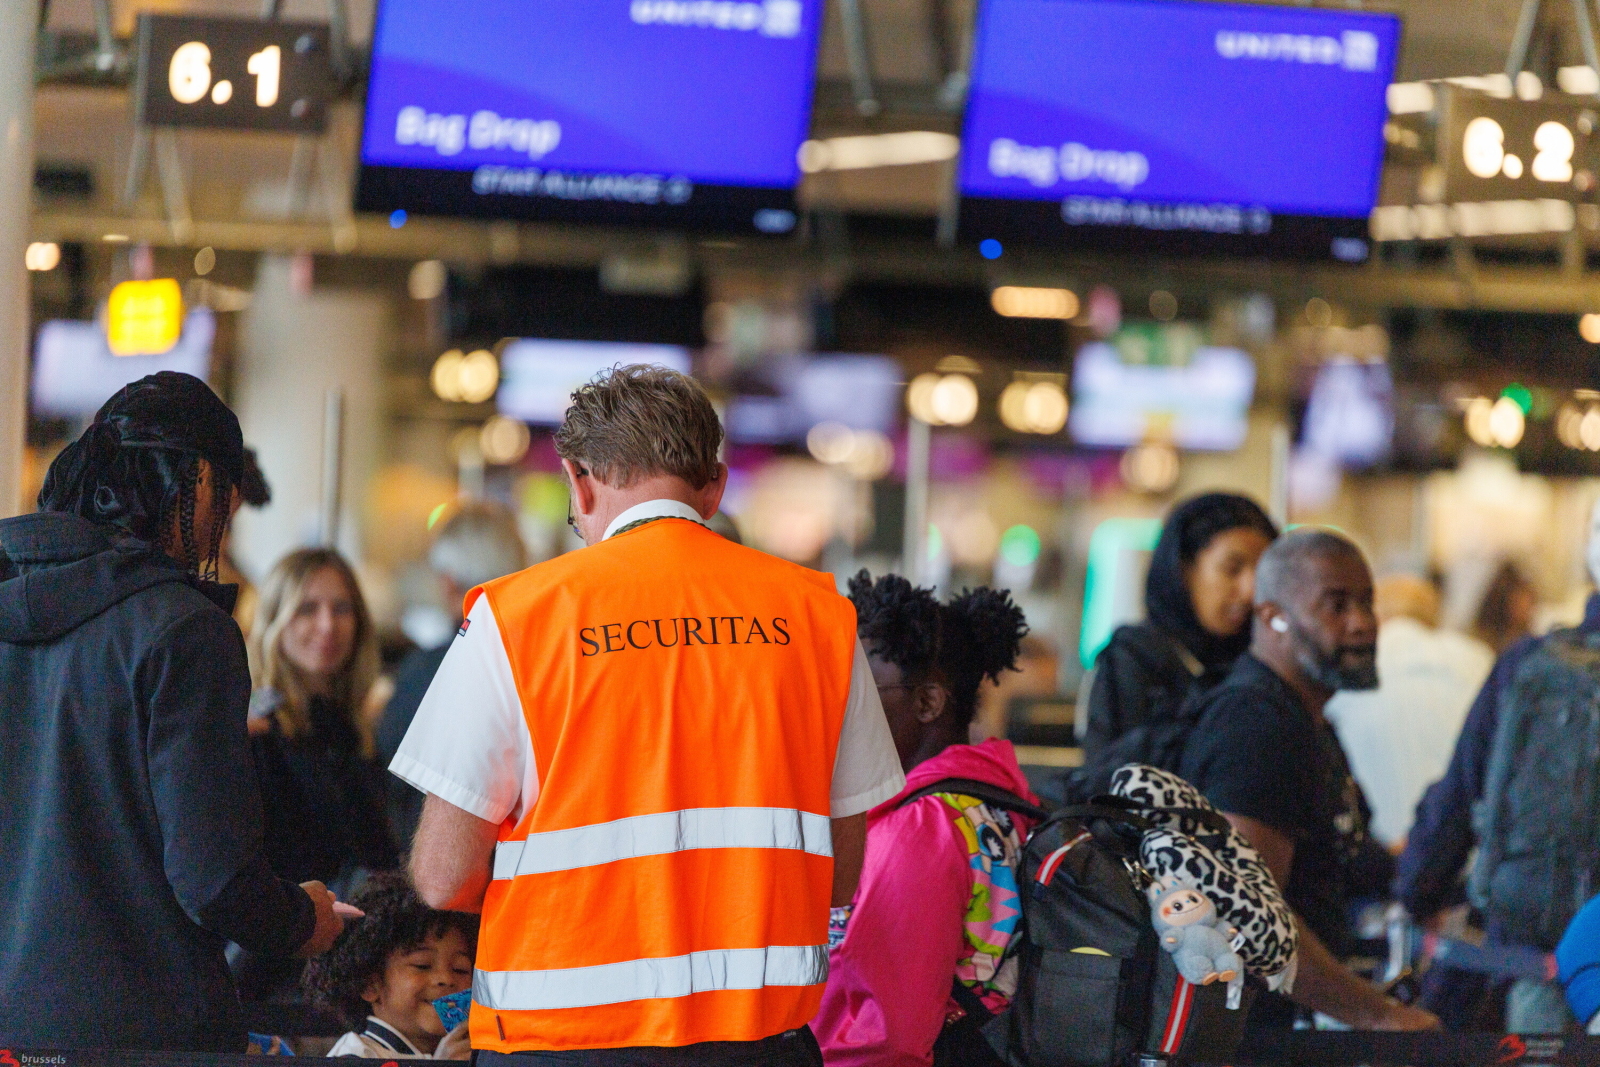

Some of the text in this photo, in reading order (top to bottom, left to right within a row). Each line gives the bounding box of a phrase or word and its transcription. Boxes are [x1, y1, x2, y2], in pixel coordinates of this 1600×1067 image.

[630, 0, 763, 30] UNITED
[1215, 30, 1342, 64] UNITED
[169, 41, 281, 107] 6.1
[396, 106, 561, 159] Bag Drop
[1463, 117, 1574, 182] 6.2
[989, 138, 1149, 190] Bag Drop
[579, 616, 791, 657] SECURITAS
[21, 1053, 67, 1064] brussels
